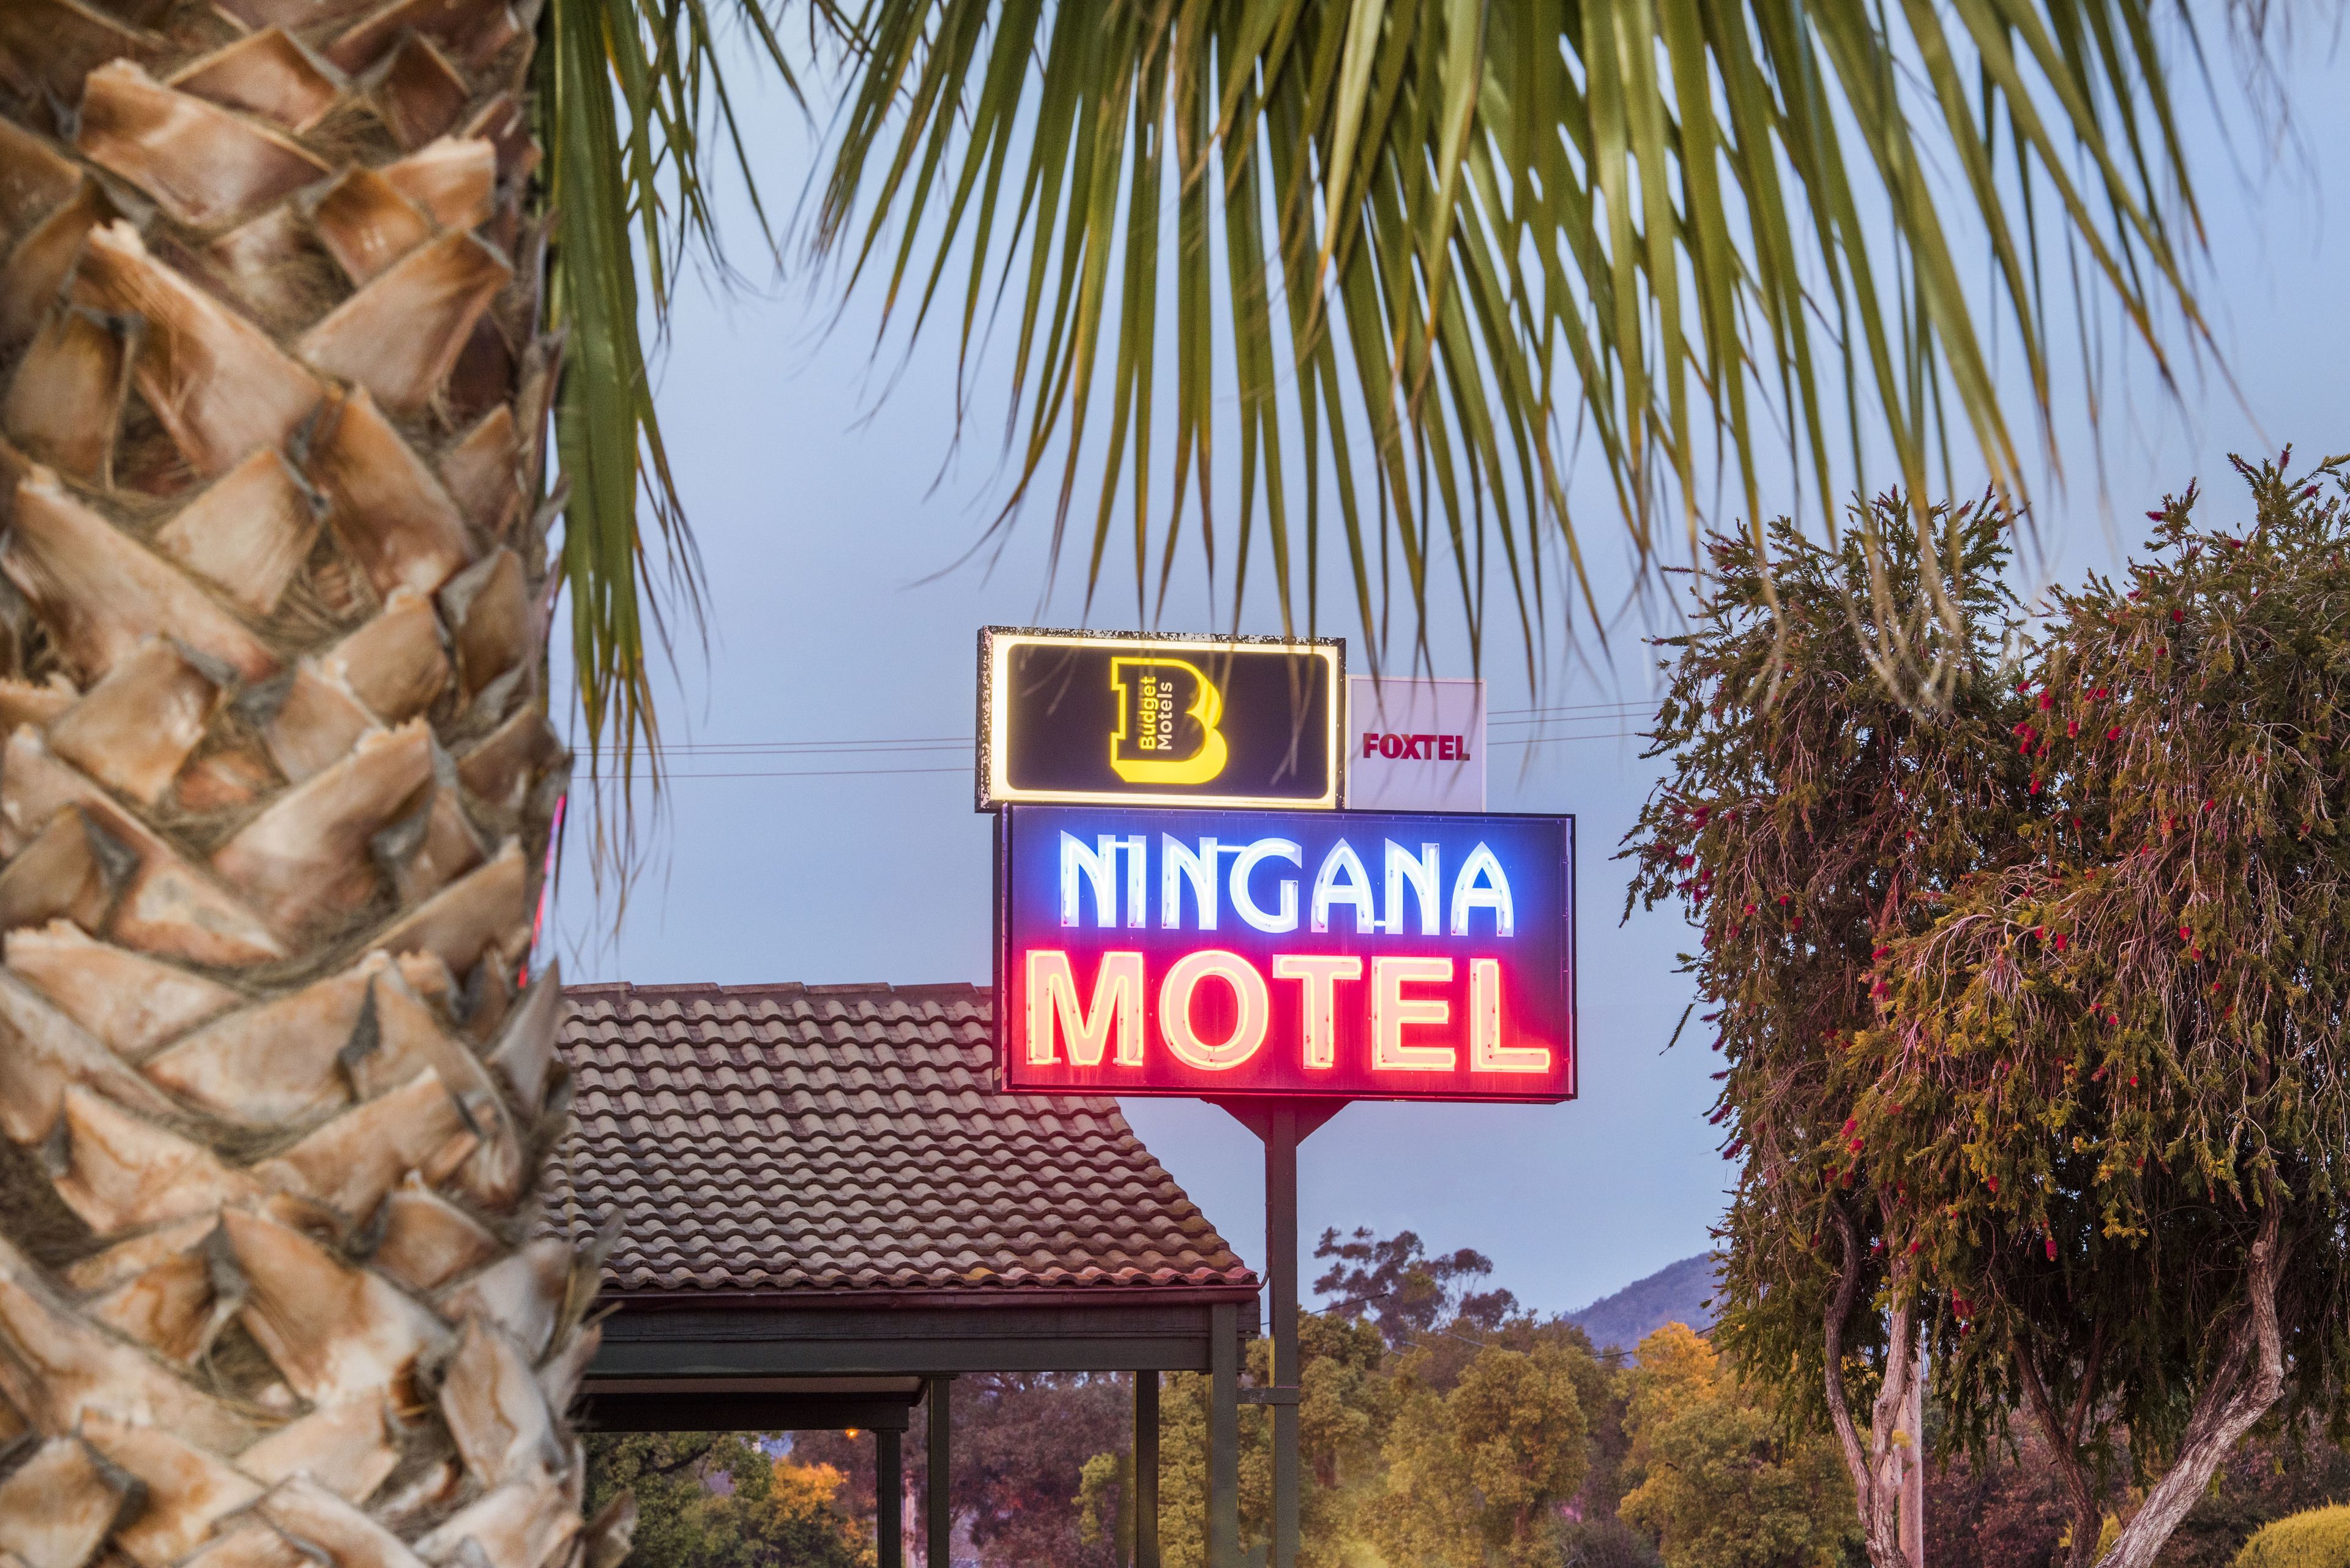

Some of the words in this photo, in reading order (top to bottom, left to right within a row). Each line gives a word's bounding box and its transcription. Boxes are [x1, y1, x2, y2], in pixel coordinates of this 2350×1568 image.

[1111, 657, 1228, 784] B
[1140, 676, 1158, 750] Budget
[1157, 682, 1173, 750] Motels
[1363, 733, 1471, 761] FOXTEL
[1060, 830, 1515, 937] NINGANA
[1026, 949, 1551, 1073] MOTEL
